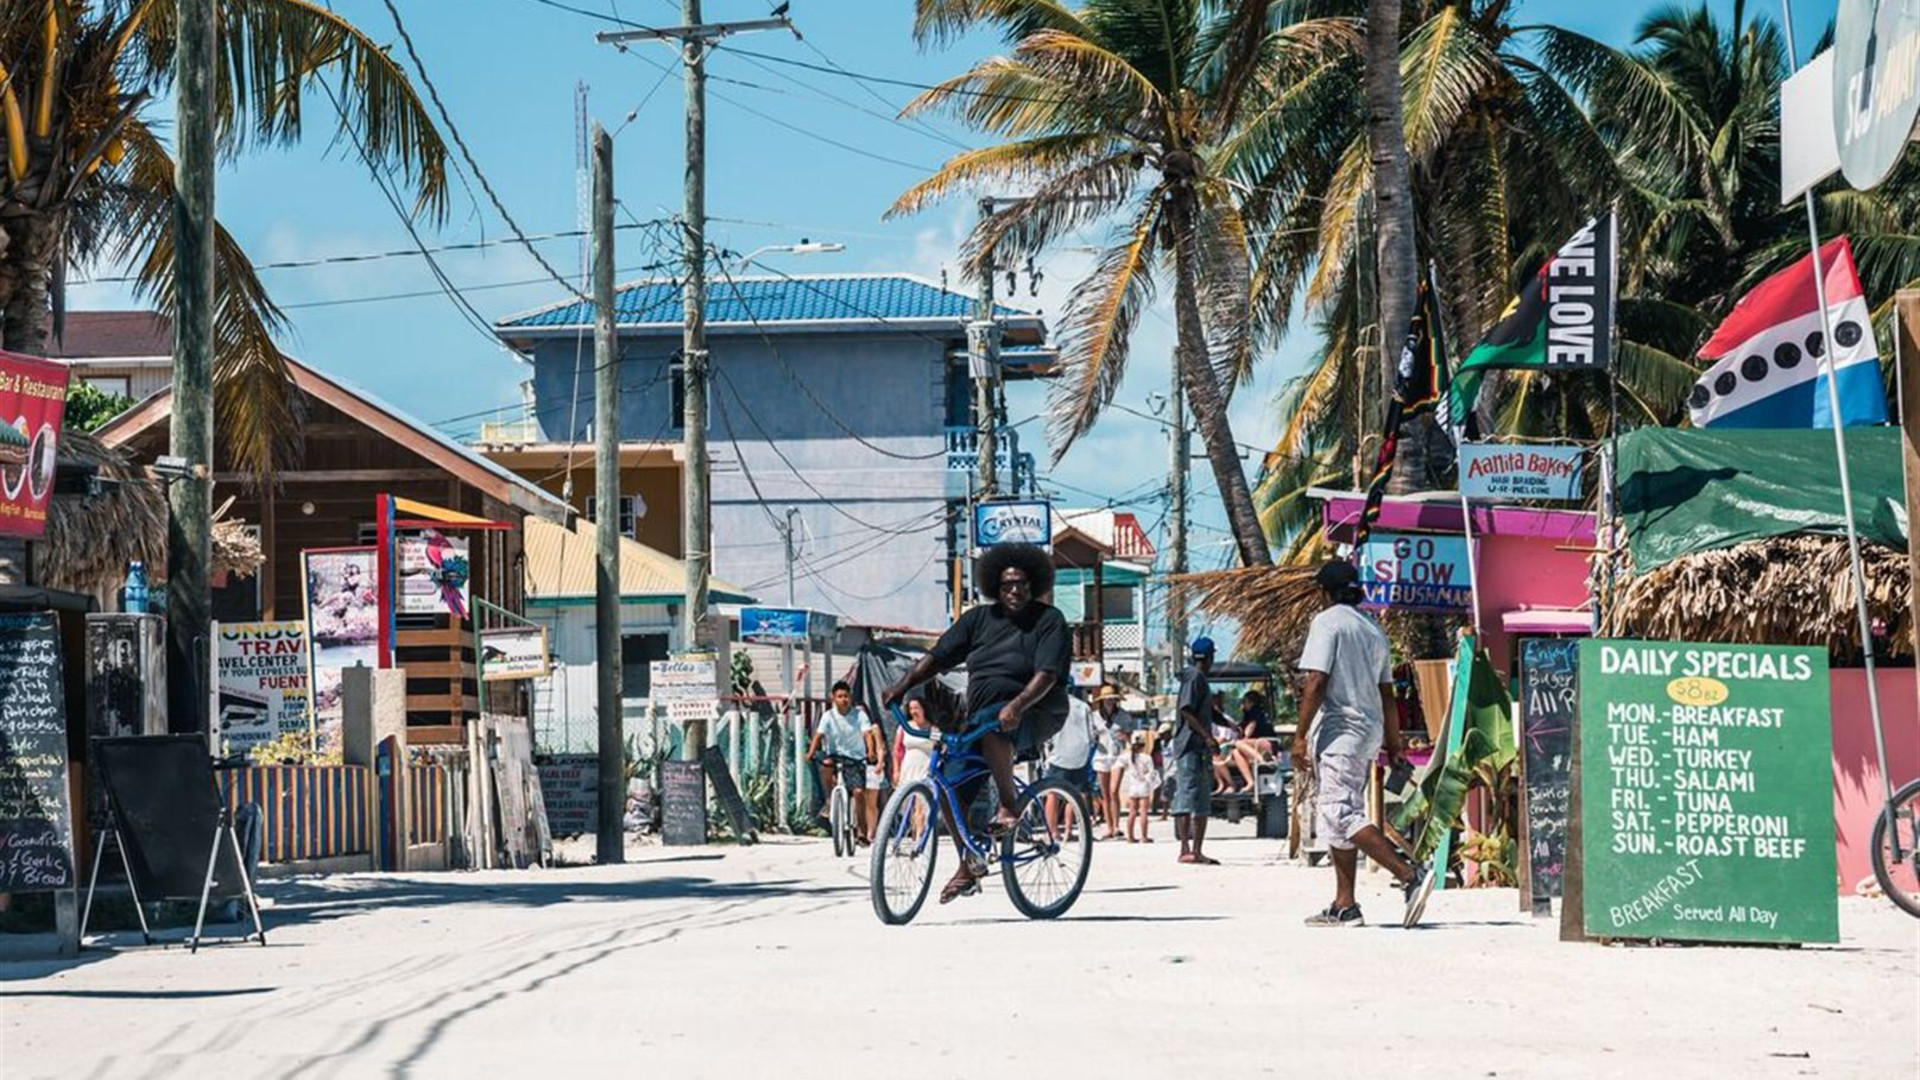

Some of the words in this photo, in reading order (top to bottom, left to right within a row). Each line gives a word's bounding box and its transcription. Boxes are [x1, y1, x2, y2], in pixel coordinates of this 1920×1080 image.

[1550, 217, 1595, 277] NE
[1549, 286, 1595, 364] LOVE
[13, 373, 20, 393] &
[1394, 537, 1434, 561] GO
[1375, 560, 1454, 584] SLOW
[219, 622, 305, 640] UNDO
[248, 655, 298, 667] CENTER
[1600, 646, 1678, 676] DAILY
[1682, 650, 1812, 680] SPECIALS
[1529, 688, 1557, 716] All
[1754, 839, 1806, 859] BEEF
[1610, 859, 1704, 928] BREAKFAST
[1673, 904, 1723, 922] Served
[1729, 906, 1746, 923] All
[1751, 908, 1778, 930] Day
